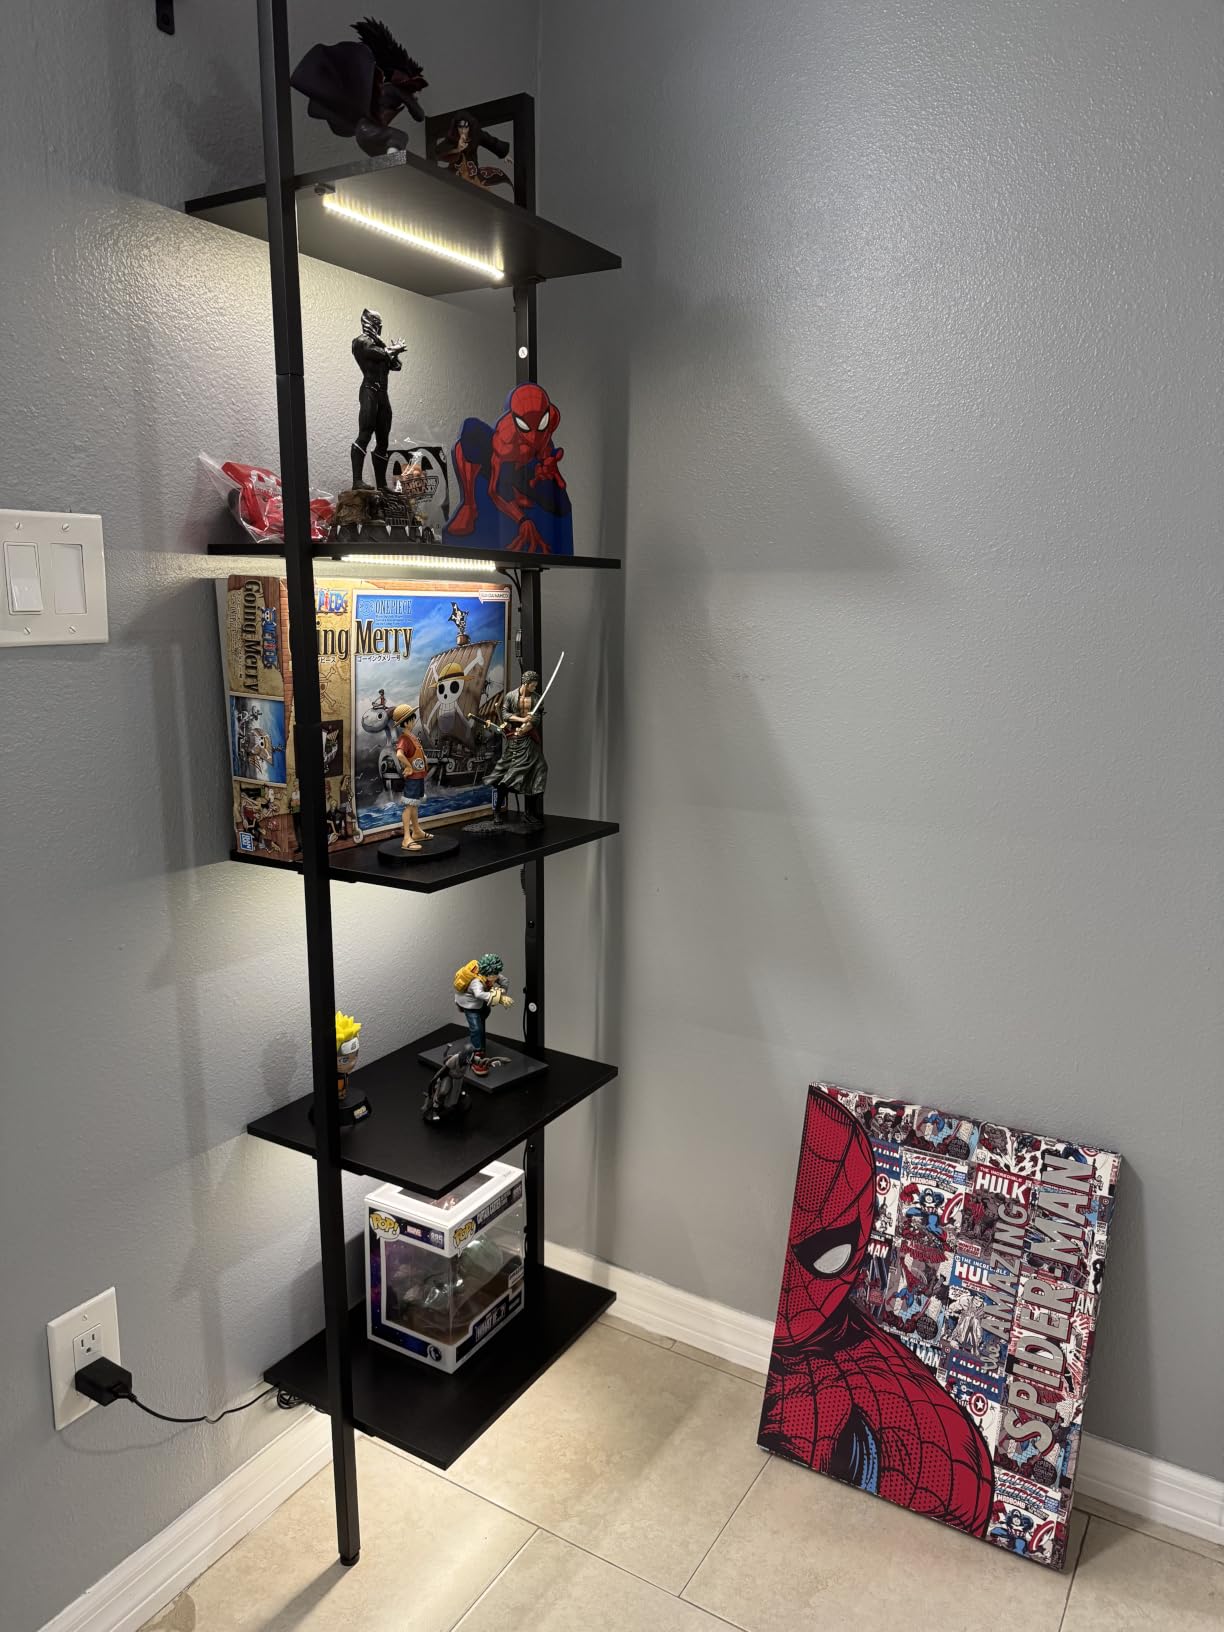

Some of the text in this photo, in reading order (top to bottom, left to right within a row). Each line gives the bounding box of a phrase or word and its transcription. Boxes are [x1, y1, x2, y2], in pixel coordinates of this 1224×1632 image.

[243, 580, 263, 692] Going Merry
[355, 620, 413, 658] Merry
[976, 1171, 1026, 1205] HULK
[370, 1212, 399, 1236] POP!
[955, 1262, 993, 1287] HUL
[979, 1202, 1028, 1342] AMAZING
[1004, 1154, 1093, 1456] SPIDER-MAN
